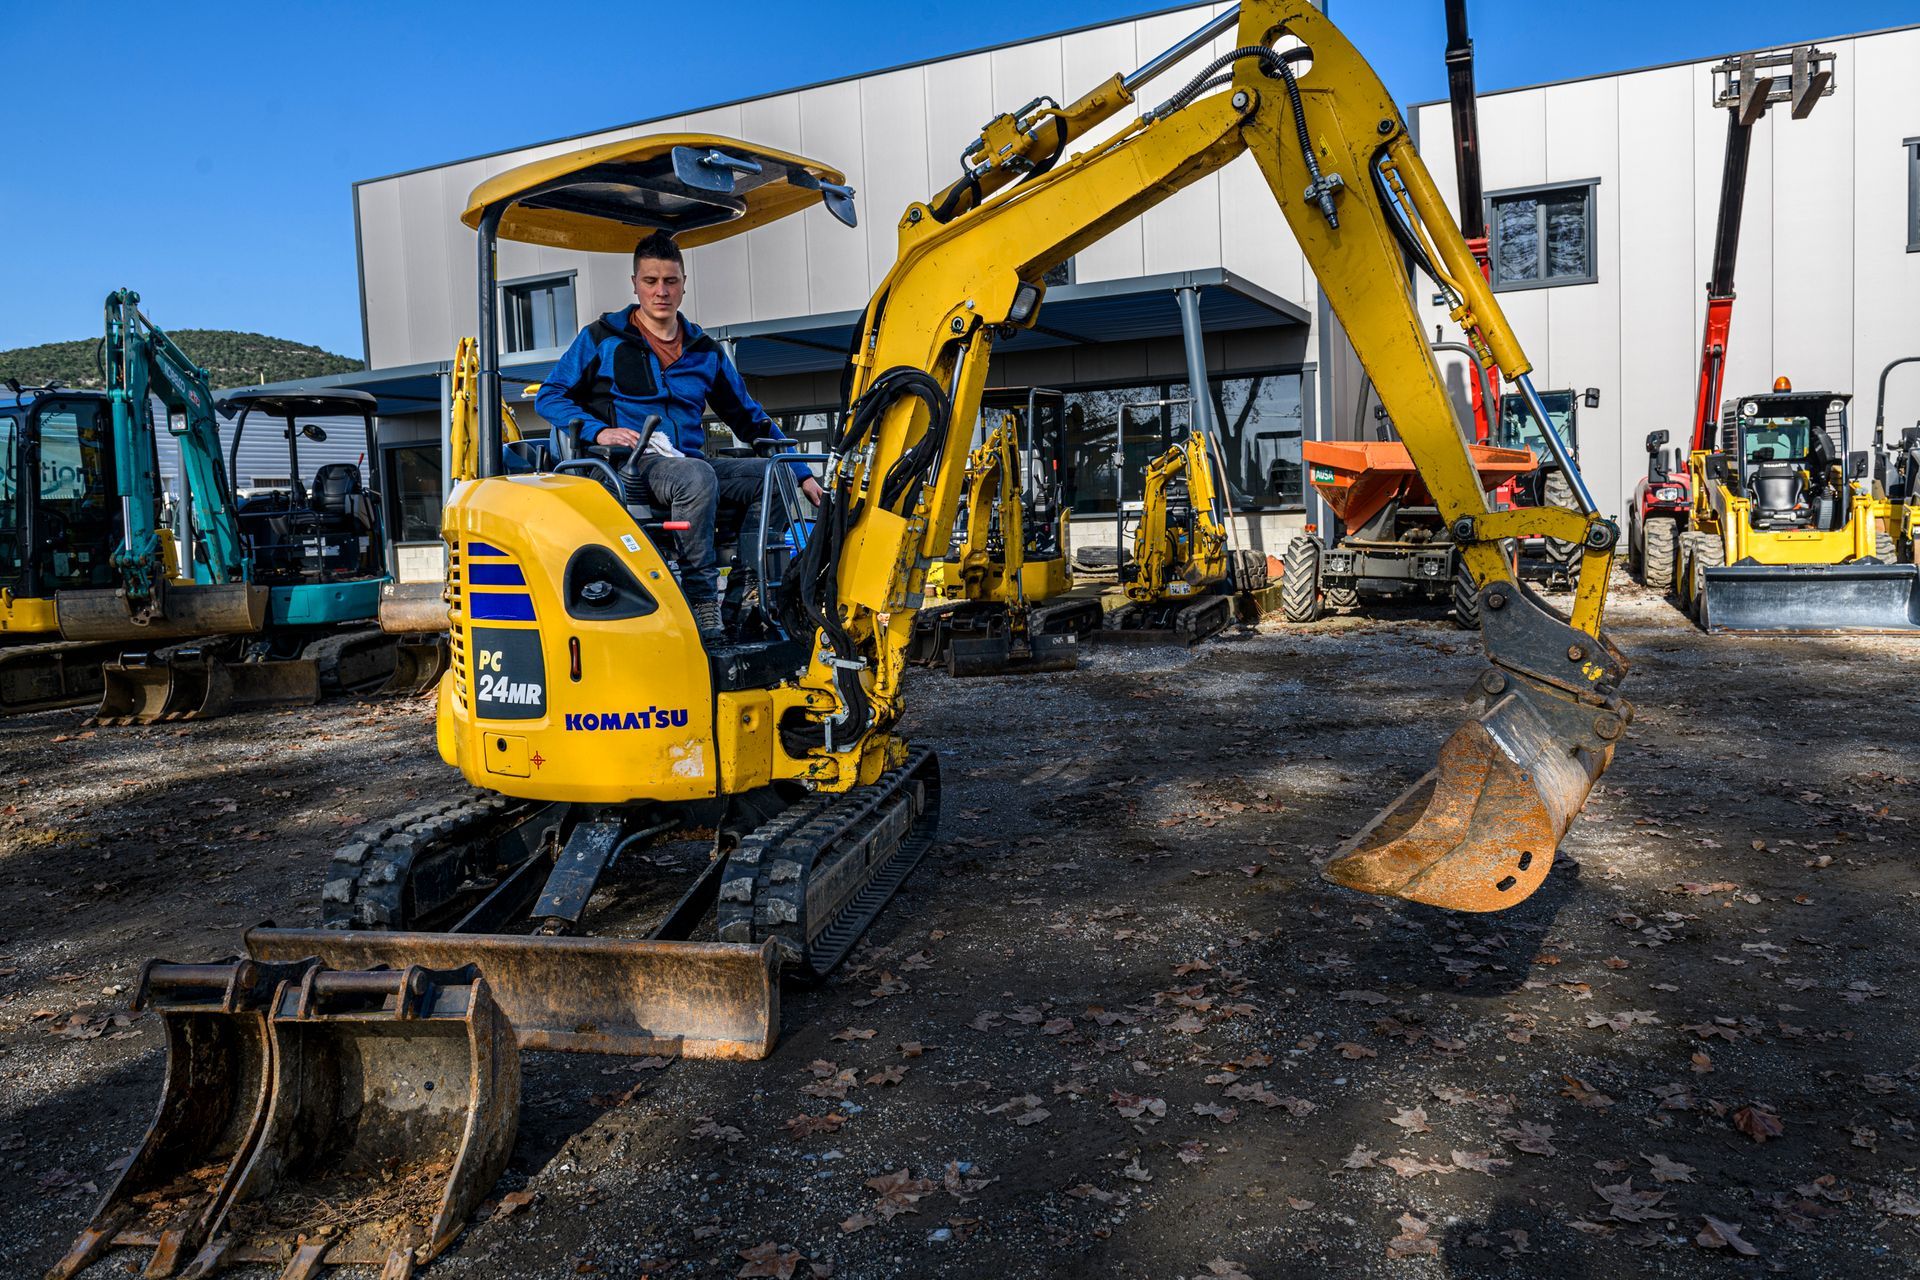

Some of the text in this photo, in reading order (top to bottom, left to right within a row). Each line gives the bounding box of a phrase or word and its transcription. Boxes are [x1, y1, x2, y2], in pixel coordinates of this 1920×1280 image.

[1316, 469, 1334, 481] AUSA
[478, 650, 503, 672] PC
[478, 674, 542, 705] 24MR
[565, 706, 688, 731] KOMATSU
